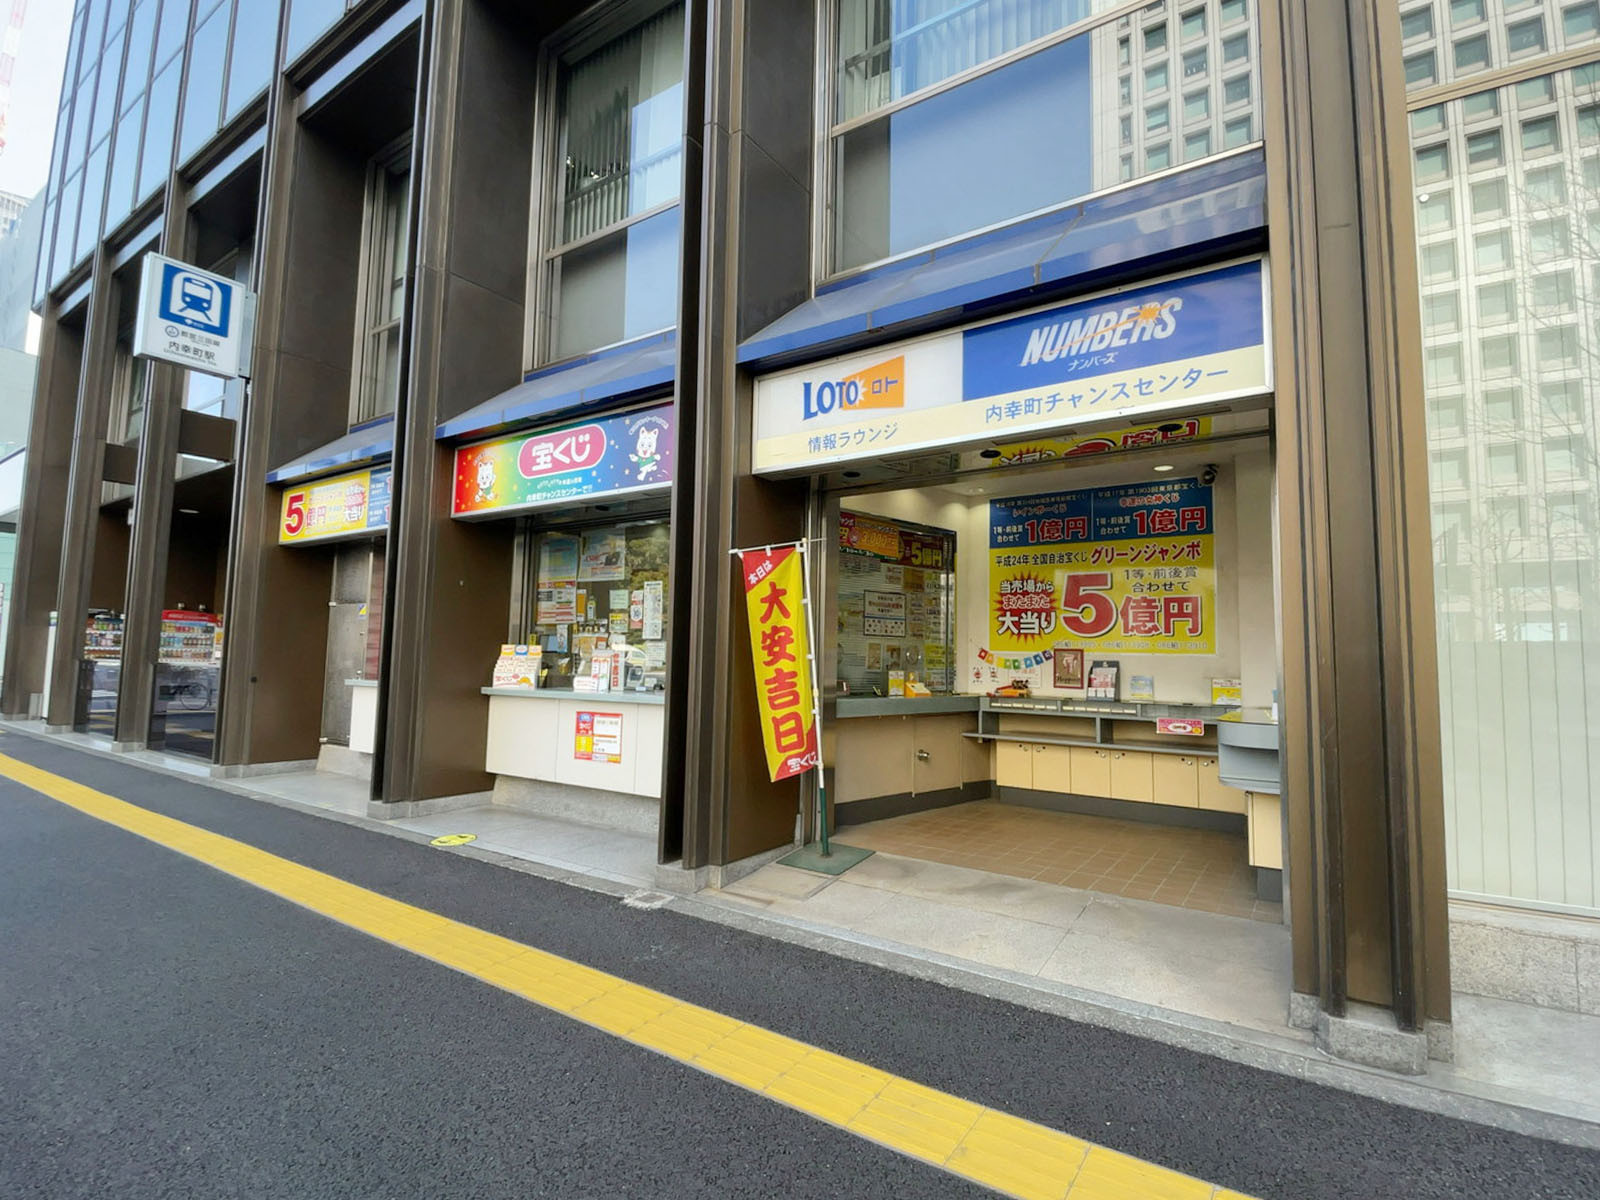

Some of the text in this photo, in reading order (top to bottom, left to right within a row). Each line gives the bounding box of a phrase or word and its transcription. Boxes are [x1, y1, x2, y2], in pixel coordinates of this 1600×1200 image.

[1020, 297, 1183, 367] NUMBERS
[168, 341, 216, 361] 内幸町駅
[1067, 352, 1119, 372] ナンバーズ
[871, 377, 899, 395] ロト
[985, 367, 1229, 424] 内幸町チャンスセンター
[802, 379, 859, 421] LOTO
[808, 422, 898, 453] 情報ラウンジ
[531, 434, 591, 472] 宝くじ
[1025, 516, 1088, 543] 1億円
[1099, 526, 1128, 536] 合わせて
[1132, 506, 1206, 536] 1億円
[995, 551, 1088, 568] 平成24年 全国自治宝くじ
[1091, 541, 1202, 565] グリーンジャンボ
[747, 559, 774, 584] 本日は
[1124, 566, 1199, 581] 1等・前後賞
[1000, 579, 1054, 593] 当売場から
[1131, 581, 1191, 593] 合わせて
[1003, 594, 1051, 609] またまた
[1062, 571, 1203, 637] 5億円
[997, 610, 1056, 636] 大当り
[759, 581, 806, 754] 大安吉日
